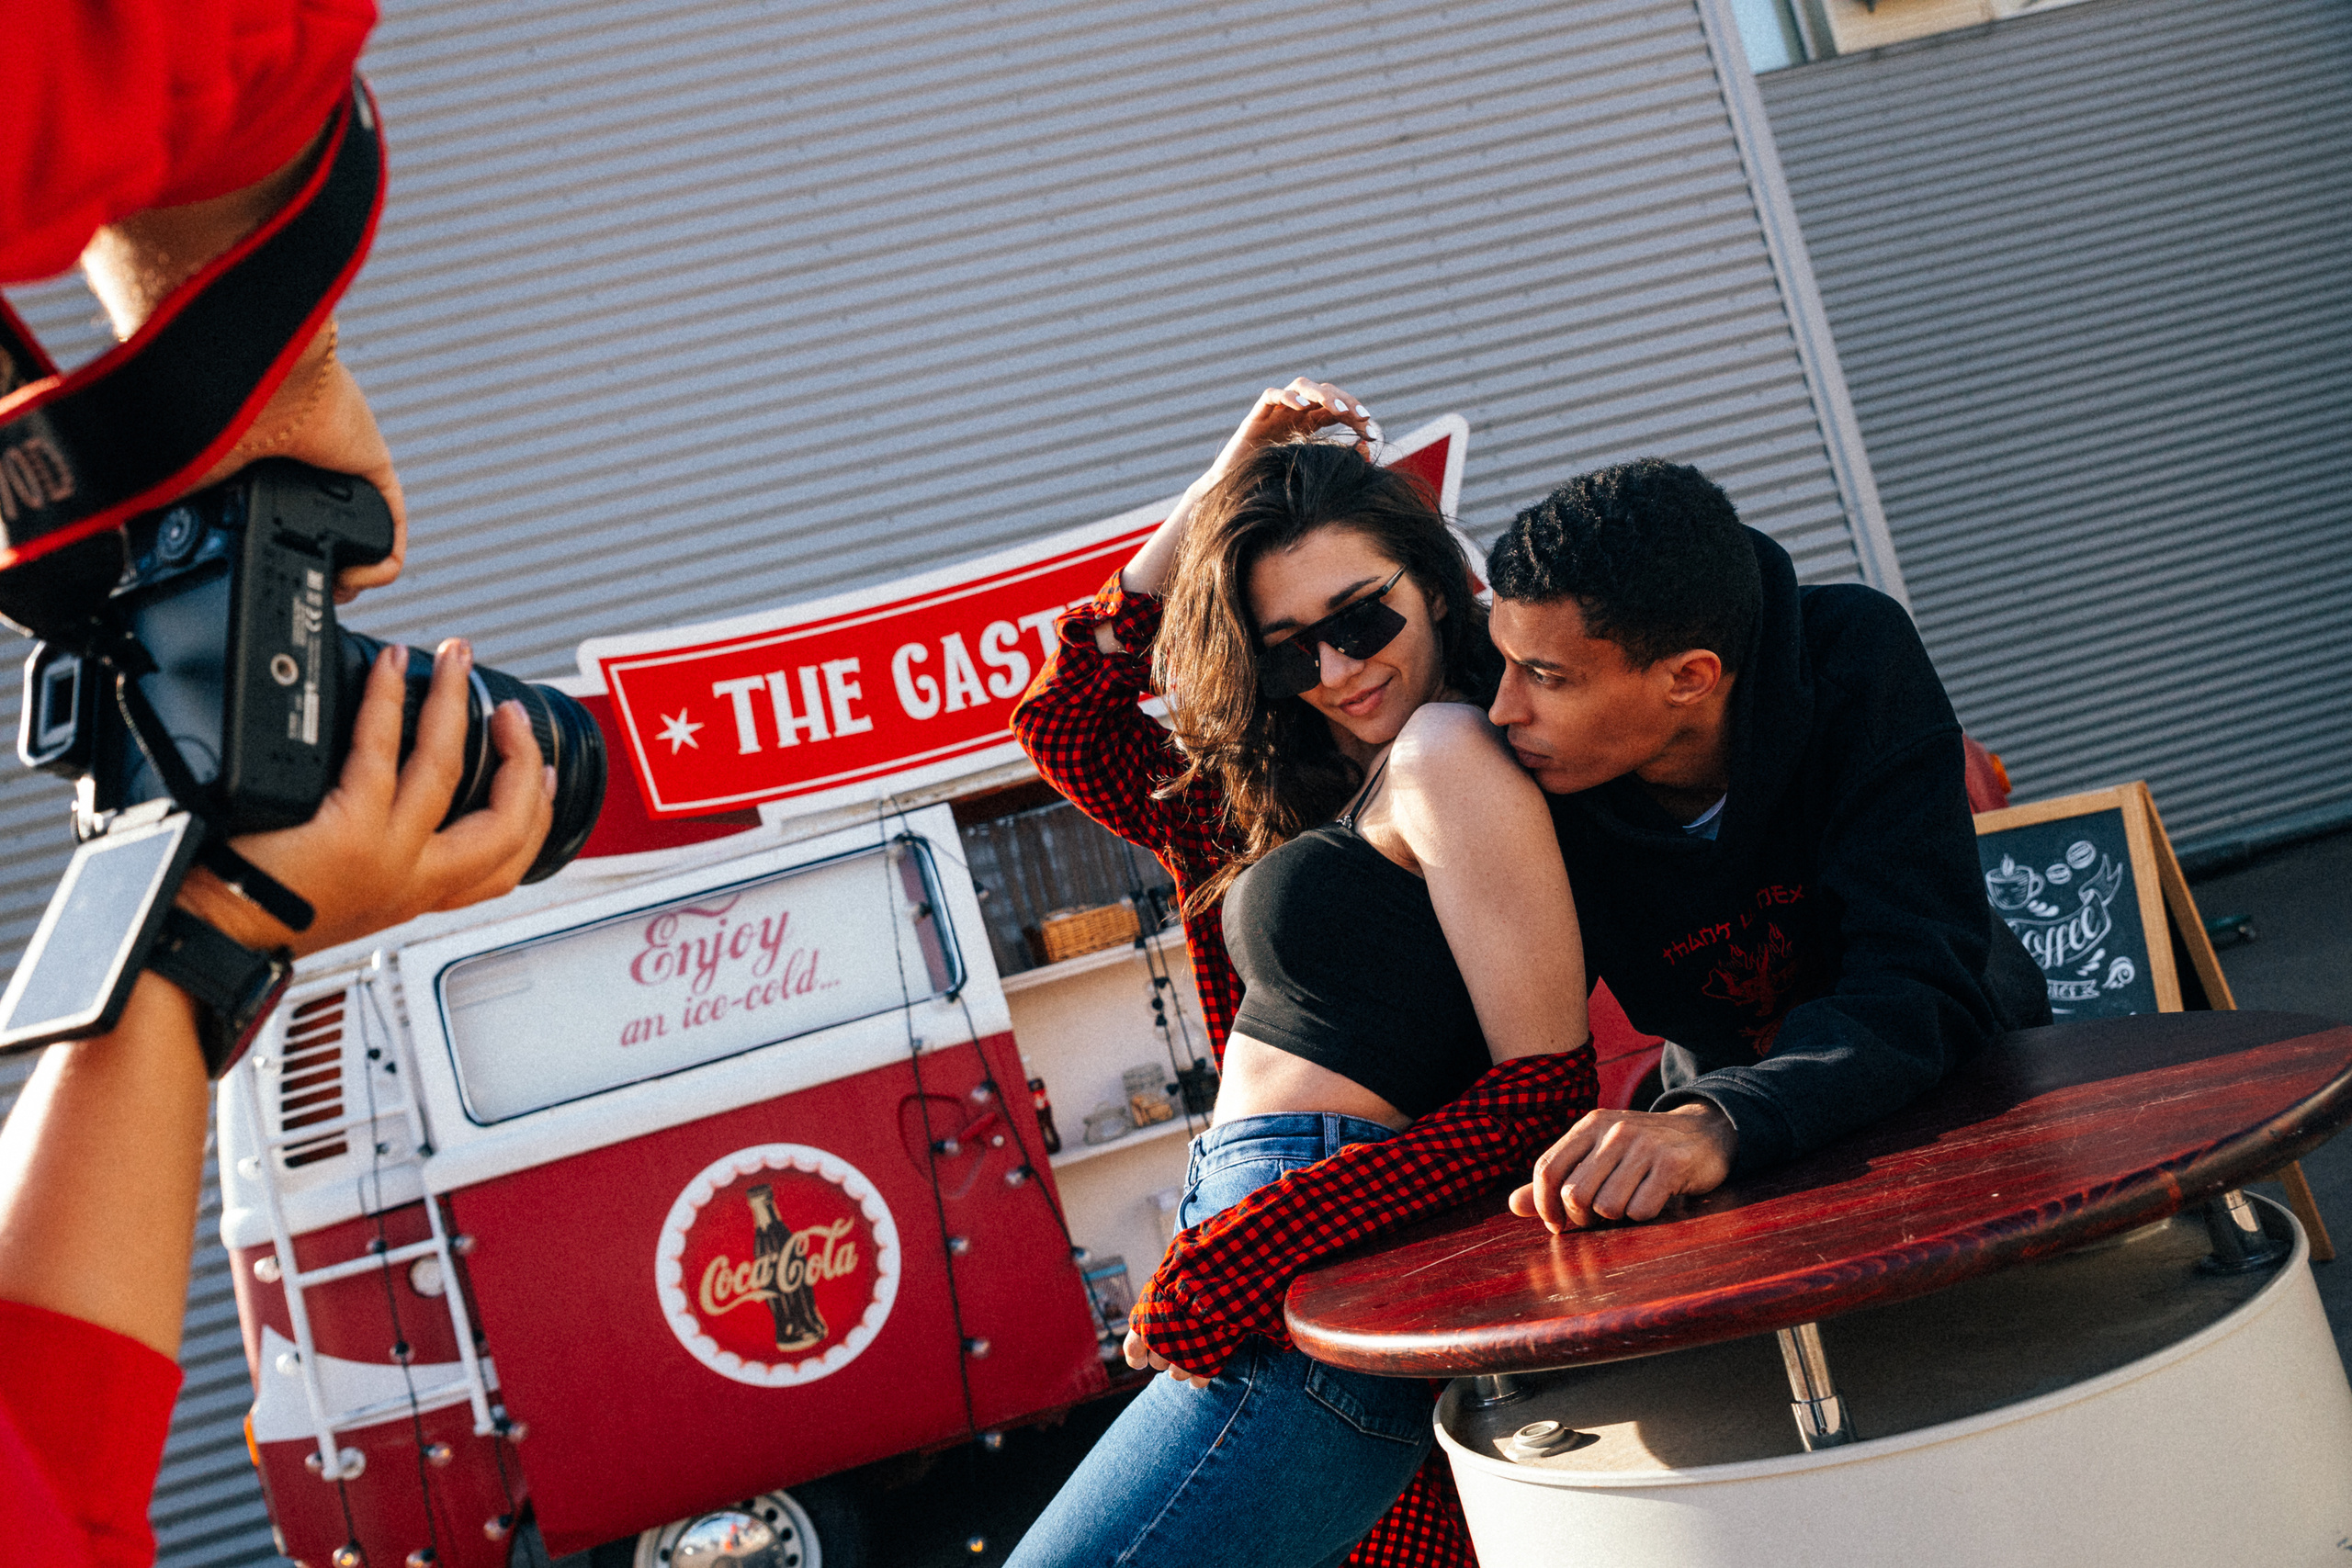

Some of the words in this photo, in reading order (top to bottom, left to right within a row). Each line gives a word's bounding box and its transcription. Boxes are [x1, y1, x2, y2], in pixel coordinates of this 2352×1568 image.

[712, 657, 874, 756] THE
[891, 594, 1095, 721] GAST
[629, 891, 790, 997] Enjoy
[619, 1013, 671, 1047] an
[698, 1214, 859, 1317] Coca-Cola
